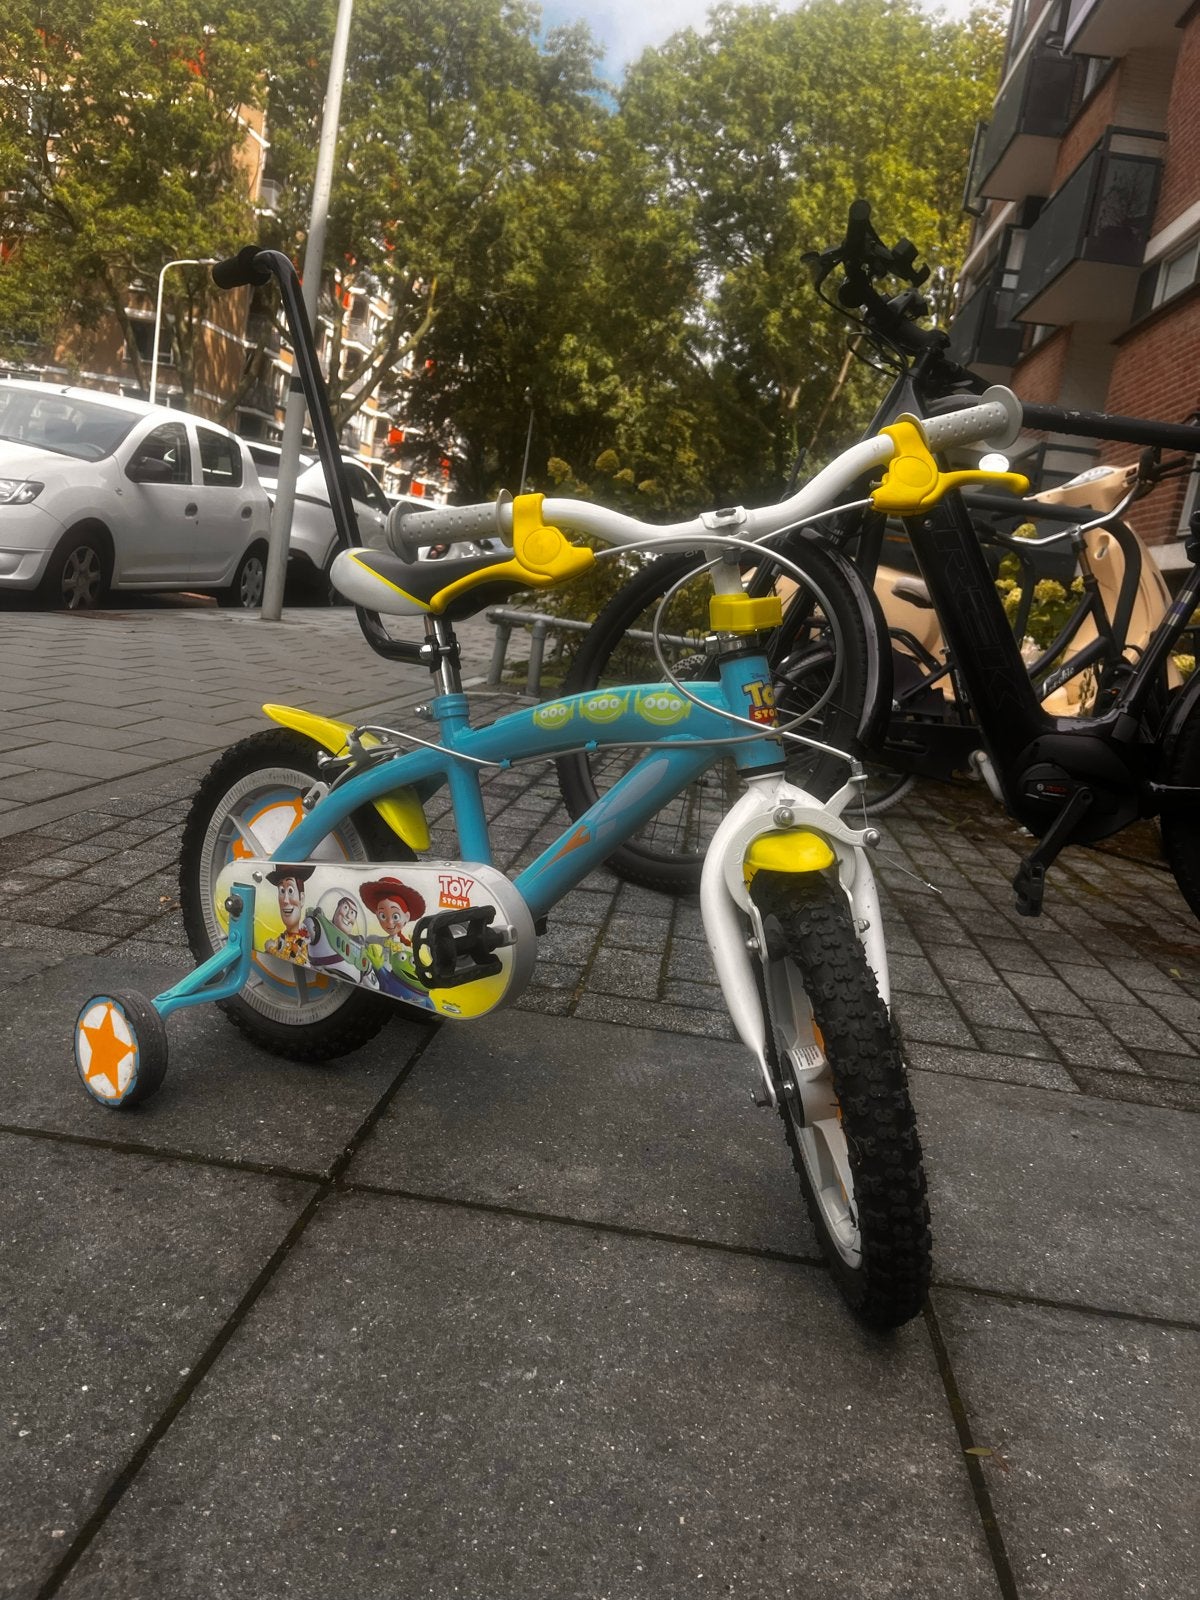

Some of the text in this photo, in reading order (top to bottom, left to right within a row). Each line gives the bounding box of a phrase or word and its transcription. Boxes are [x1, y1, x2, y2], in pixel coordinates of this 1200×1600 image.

[931, 503, 1025, 709] TREK
[742, 680, 776, 708] TO
[754, 708, 777, 720] STO
[438, 875, 475, 898] TOY
[442, 897, 468, 908] STORY
